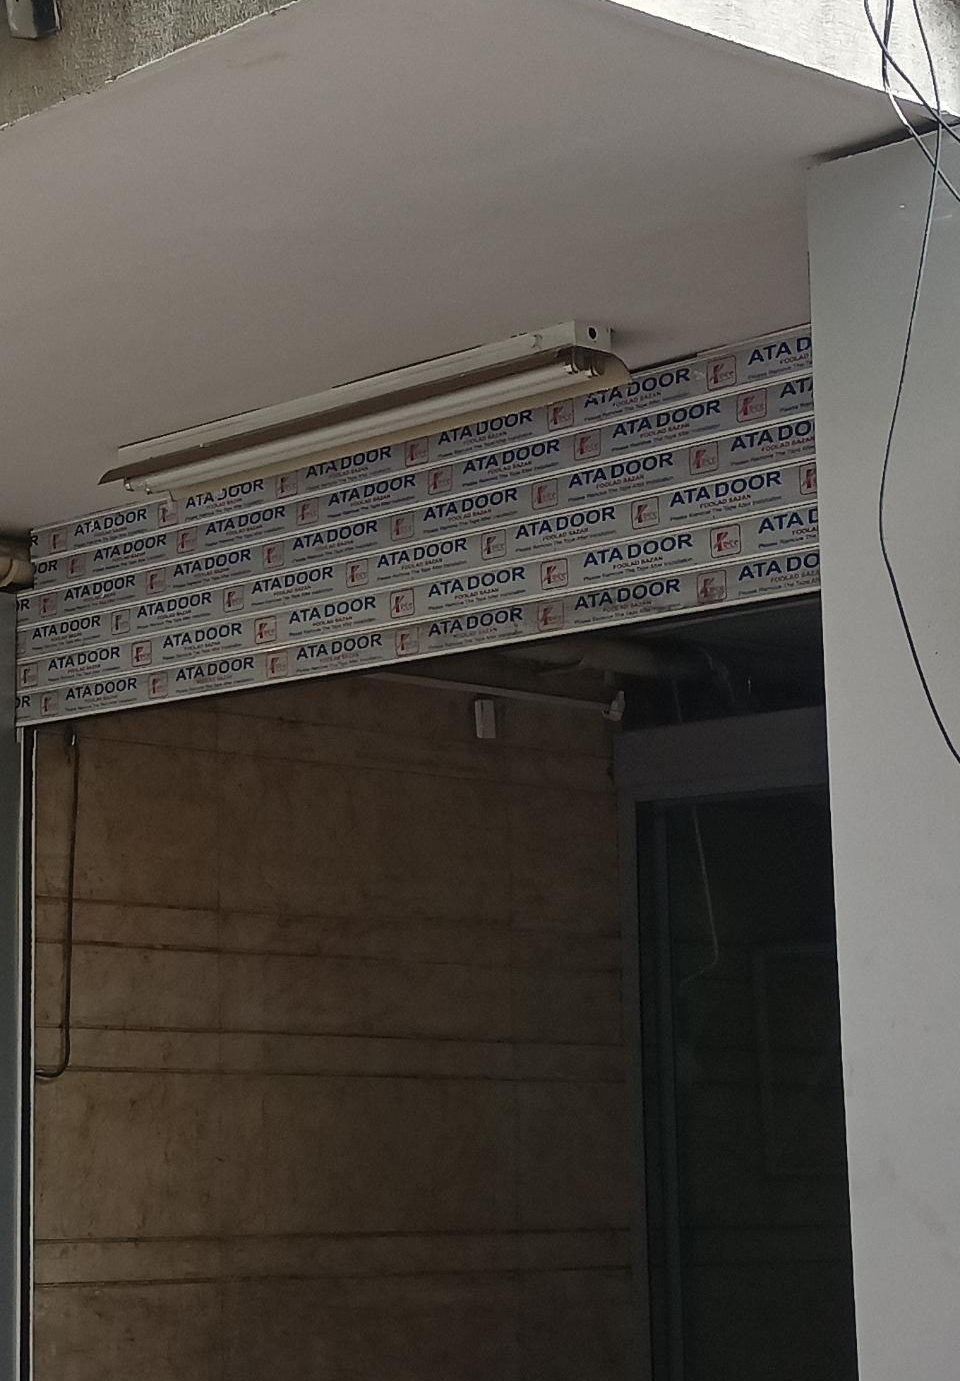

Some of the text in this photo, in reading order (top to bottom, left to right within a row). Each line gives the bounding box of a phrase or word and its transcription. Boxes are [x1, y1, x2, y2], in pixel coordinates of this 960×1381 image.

[779, 376, 814, 399] AT
[778, 420, 816, 441] DO
[32, 561, 57, 575] OR
[786, 552, 820, 573] DO
